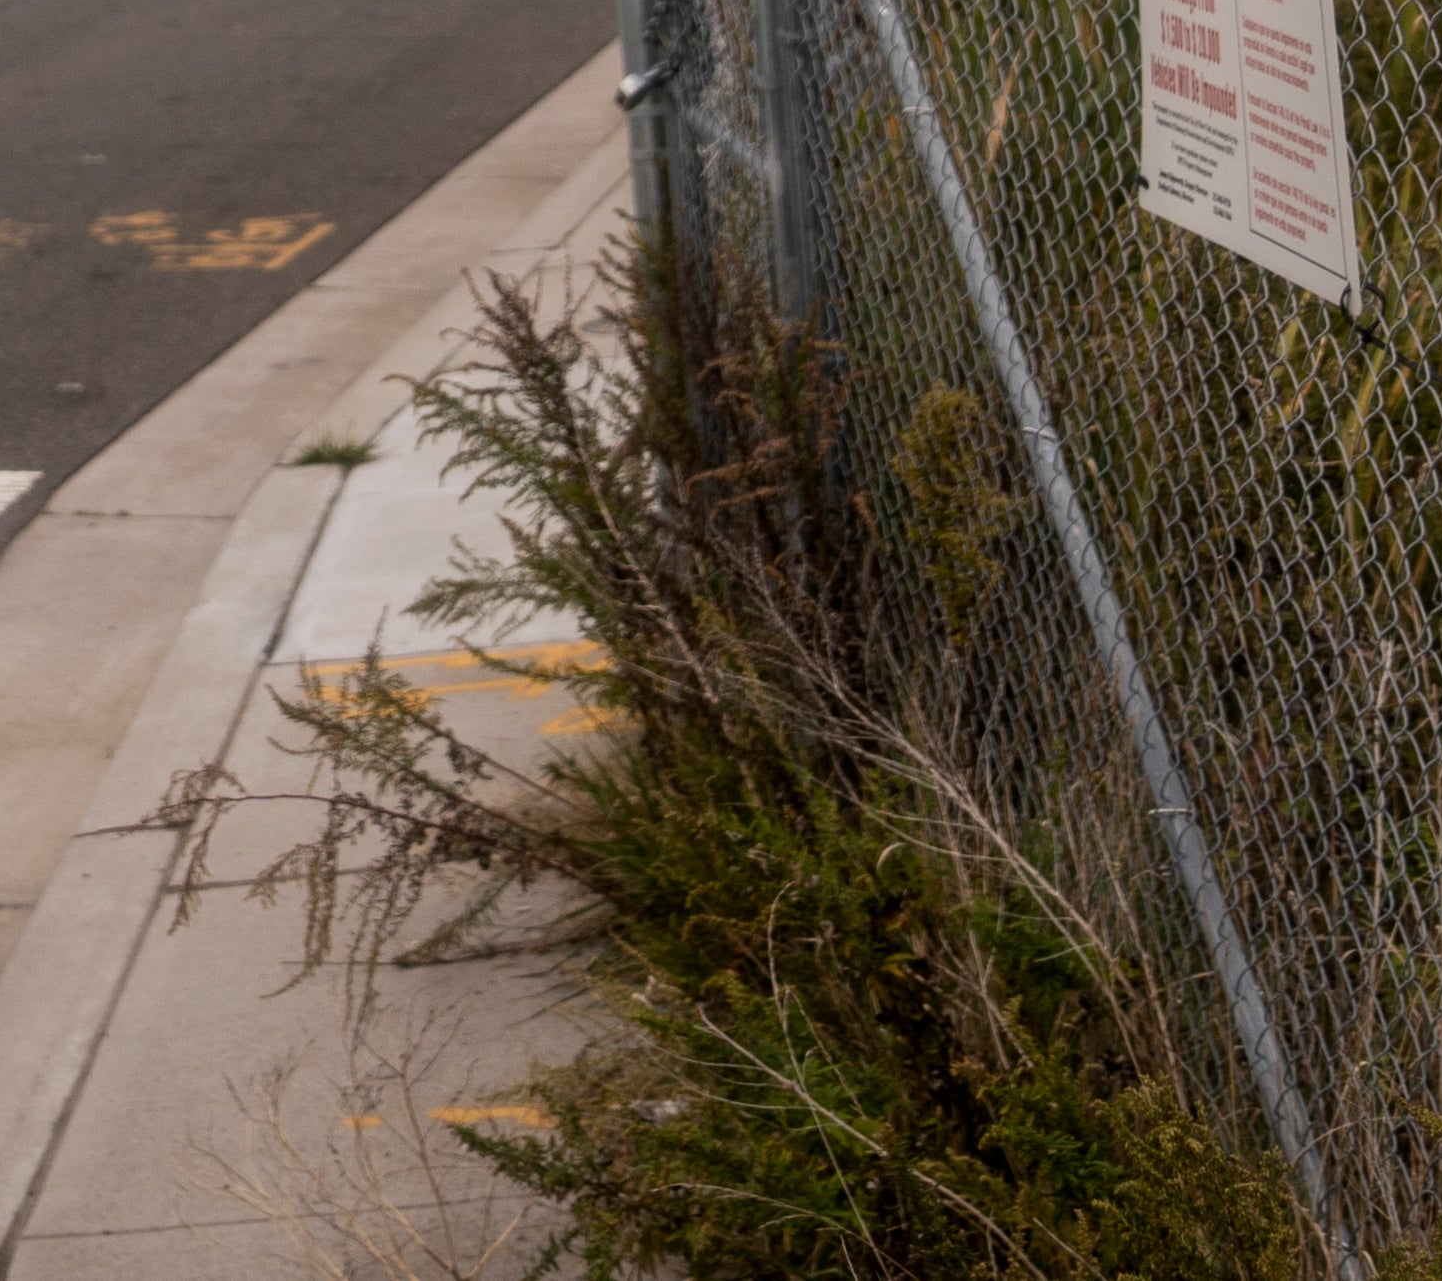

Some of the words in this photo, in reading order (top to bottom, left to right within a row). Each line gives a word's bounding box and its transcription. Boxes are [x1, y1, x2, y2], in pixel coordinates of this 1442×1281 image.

[1150, 52, 1176, 94] Vehicles
[1176, 62, 1190, 99] Will
[1190, 68, 1200, 105] Be
[1200, 72, 1237, 121] Impounded
